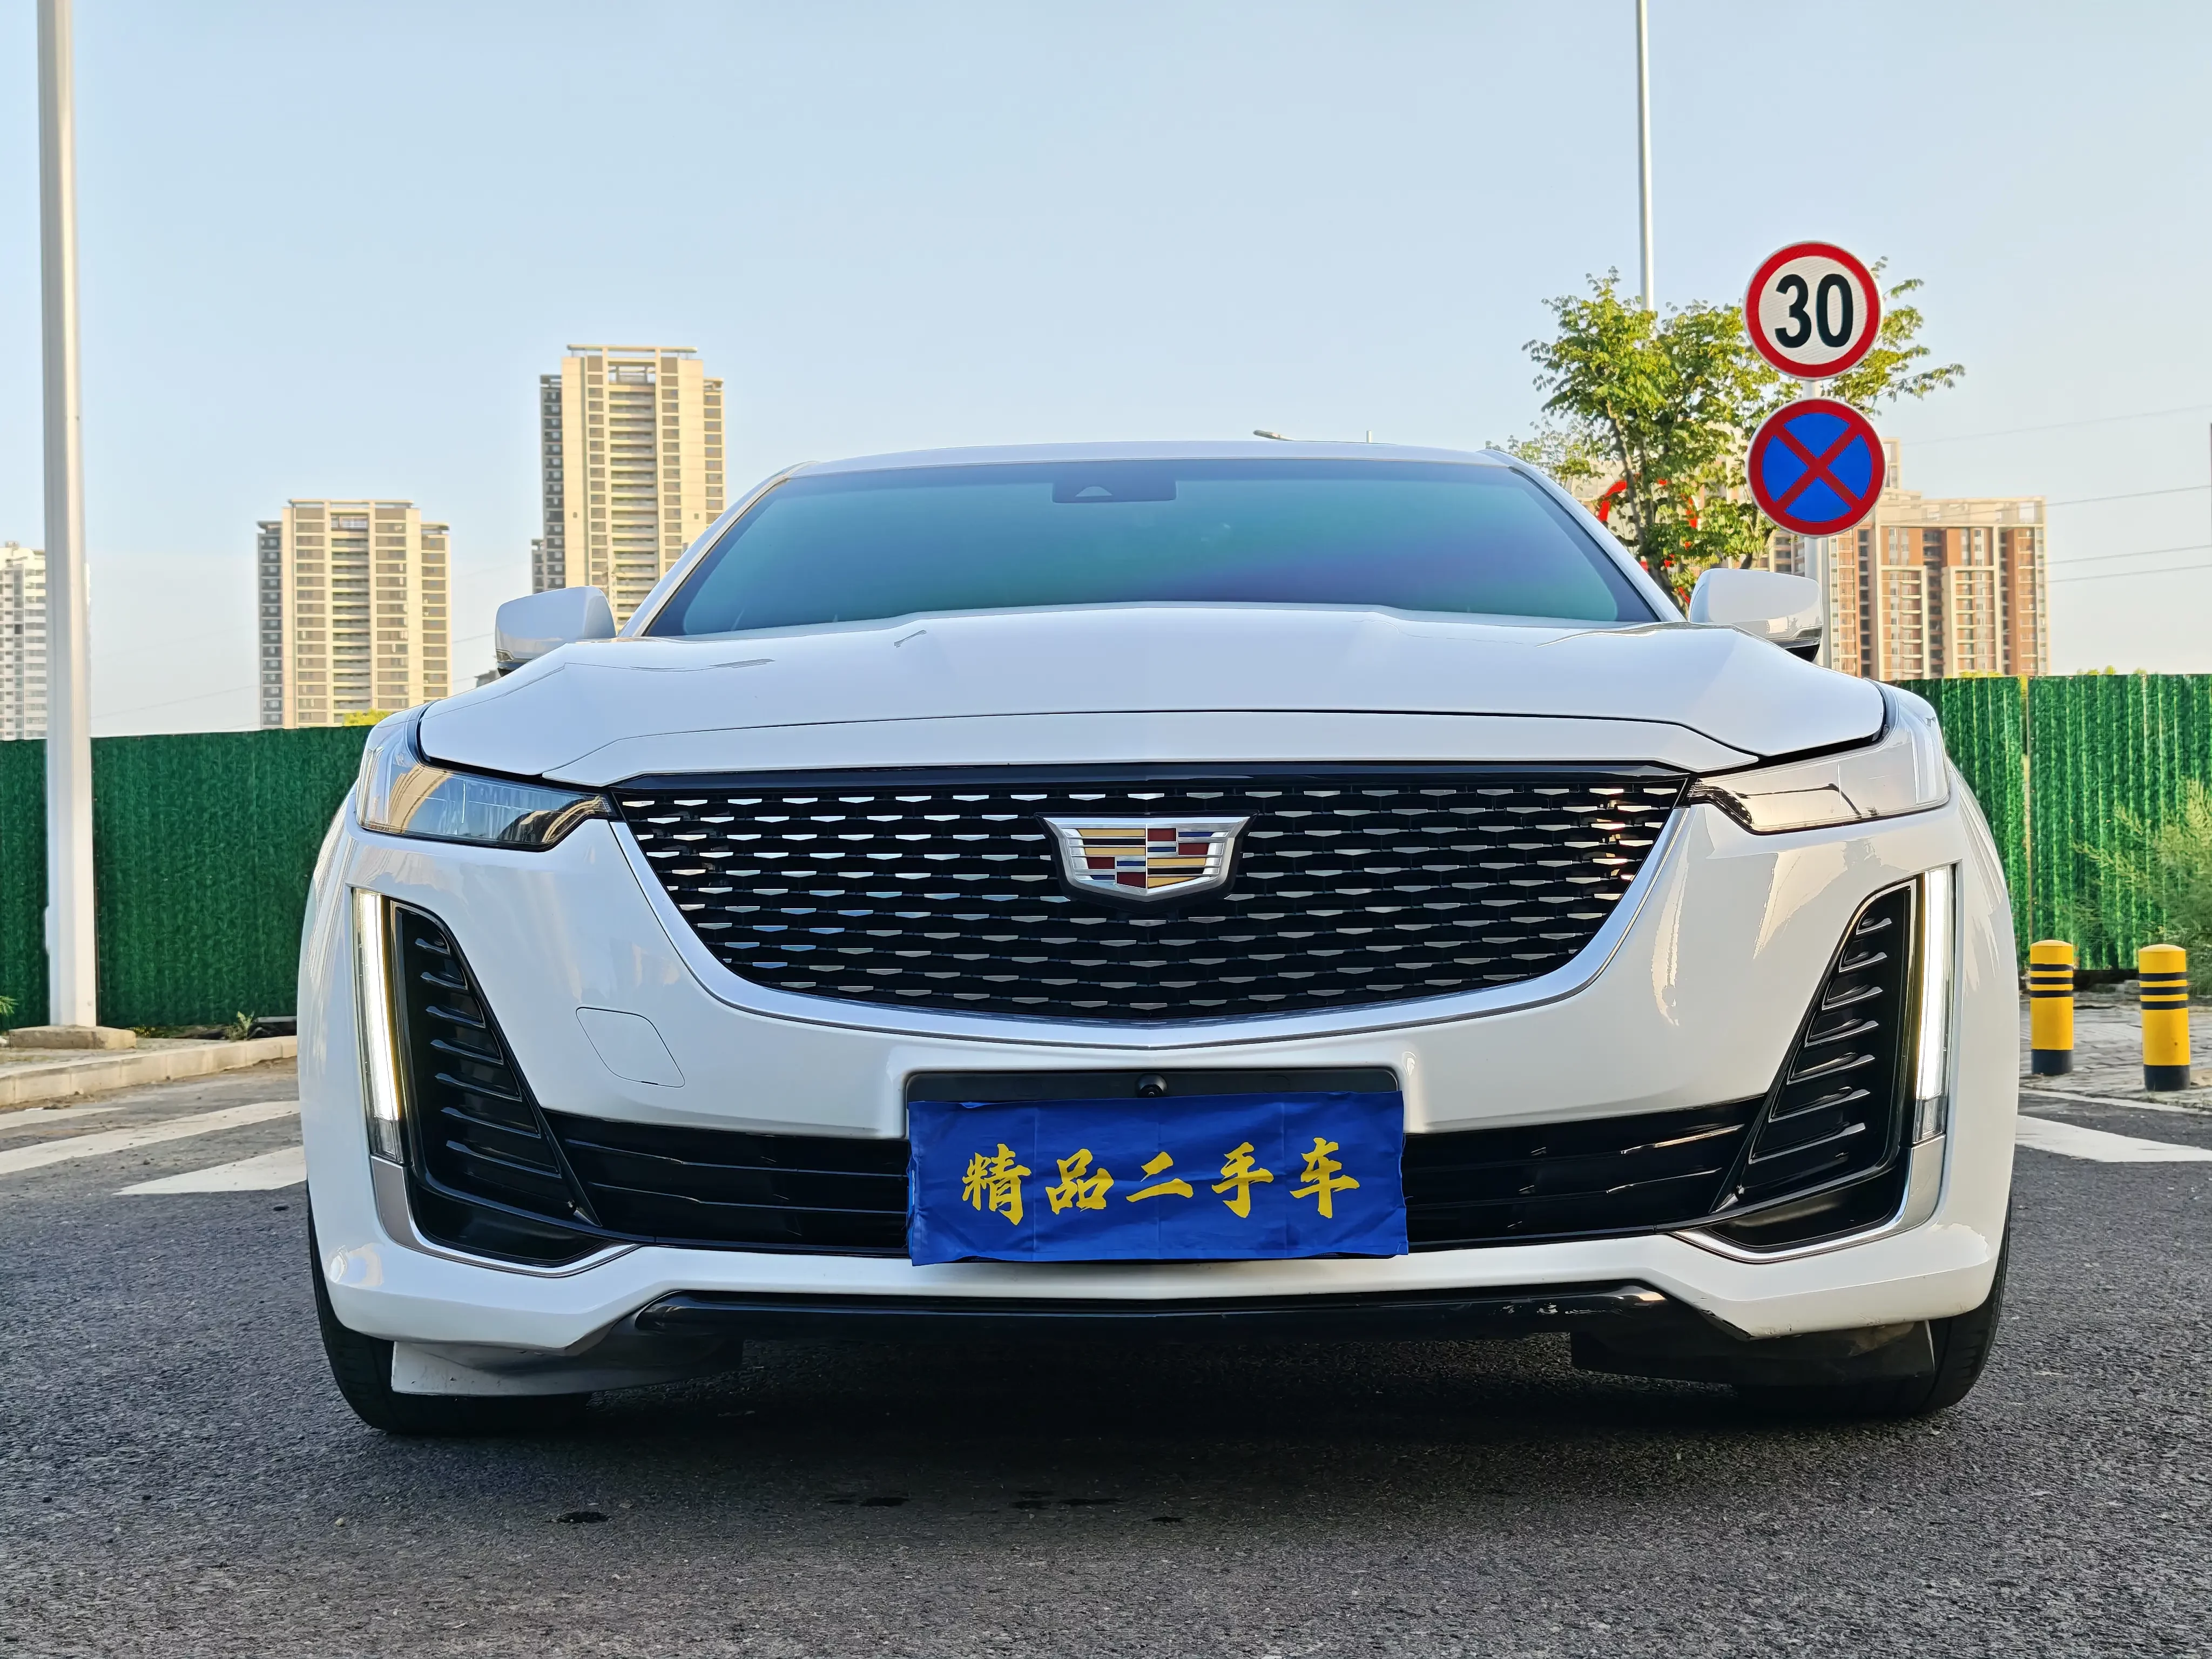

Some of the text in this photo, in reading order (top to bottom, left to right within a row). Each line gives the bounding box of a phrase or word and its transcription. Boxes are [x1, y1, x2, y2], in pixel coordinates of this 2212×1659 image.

[1775, 273, 1853, 348] 30
[962, 1137, 1360, 1225] 精品二手车
